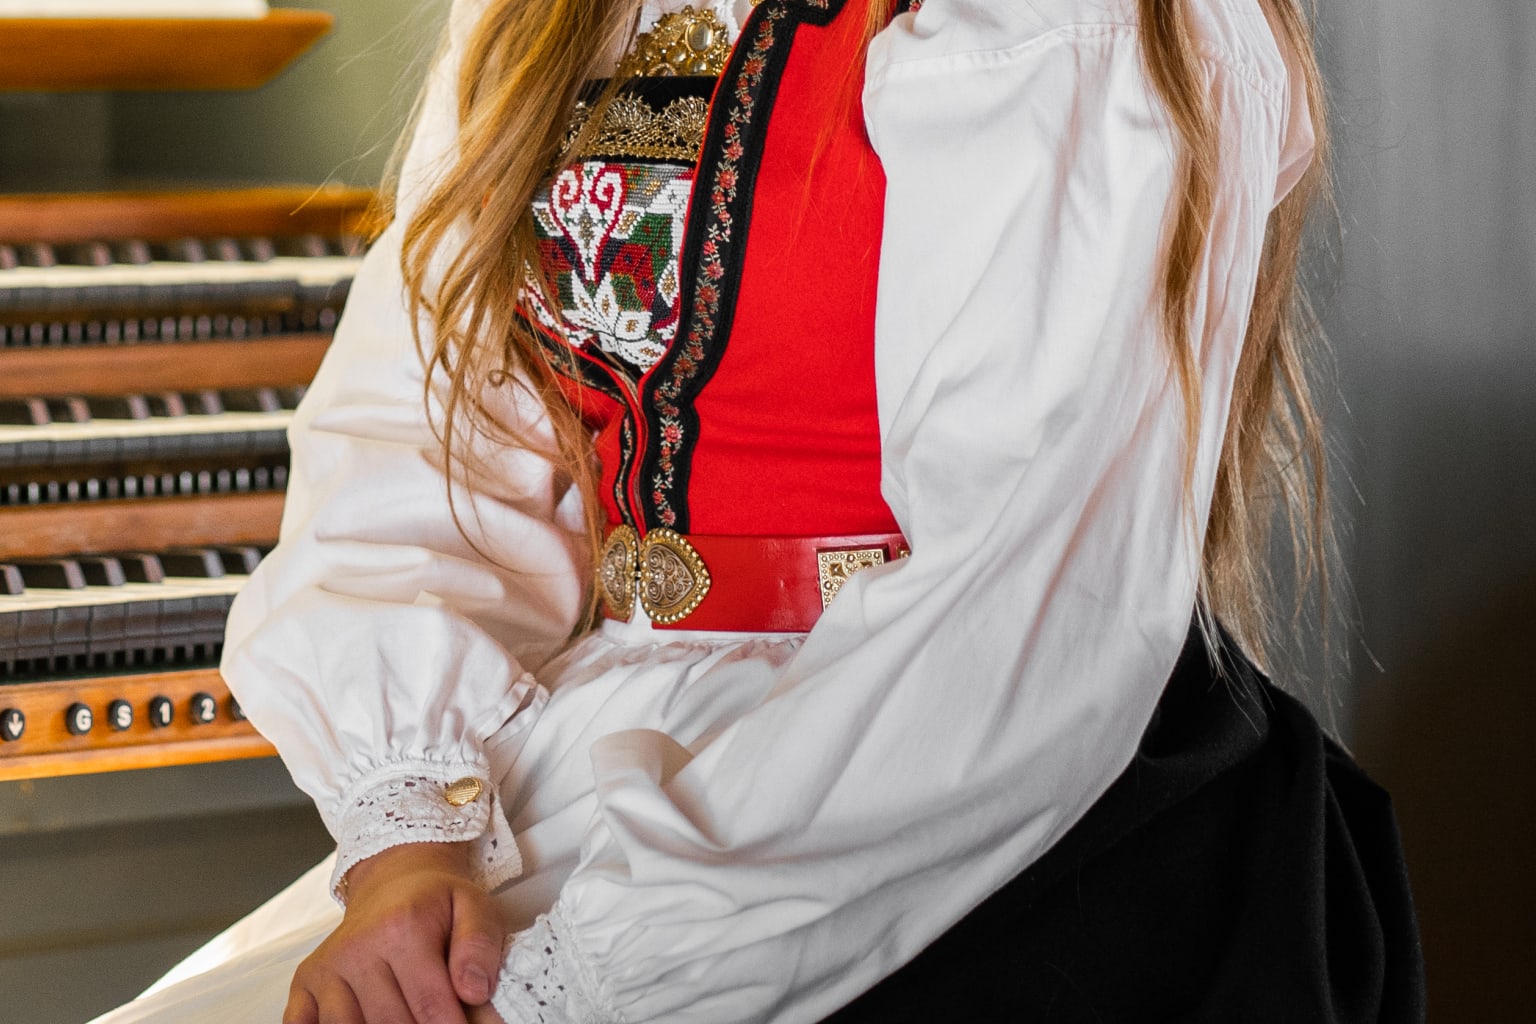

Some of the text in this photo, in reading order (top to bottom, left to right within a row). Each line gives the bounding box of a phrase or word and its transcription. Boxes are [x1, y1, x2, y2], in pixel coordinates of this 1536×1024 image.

[76, 708, 92, 732] G
[117, 705, 132, 728] S
[159, 702, 171, 724] 1
[201, 698, 216, 721] 2
